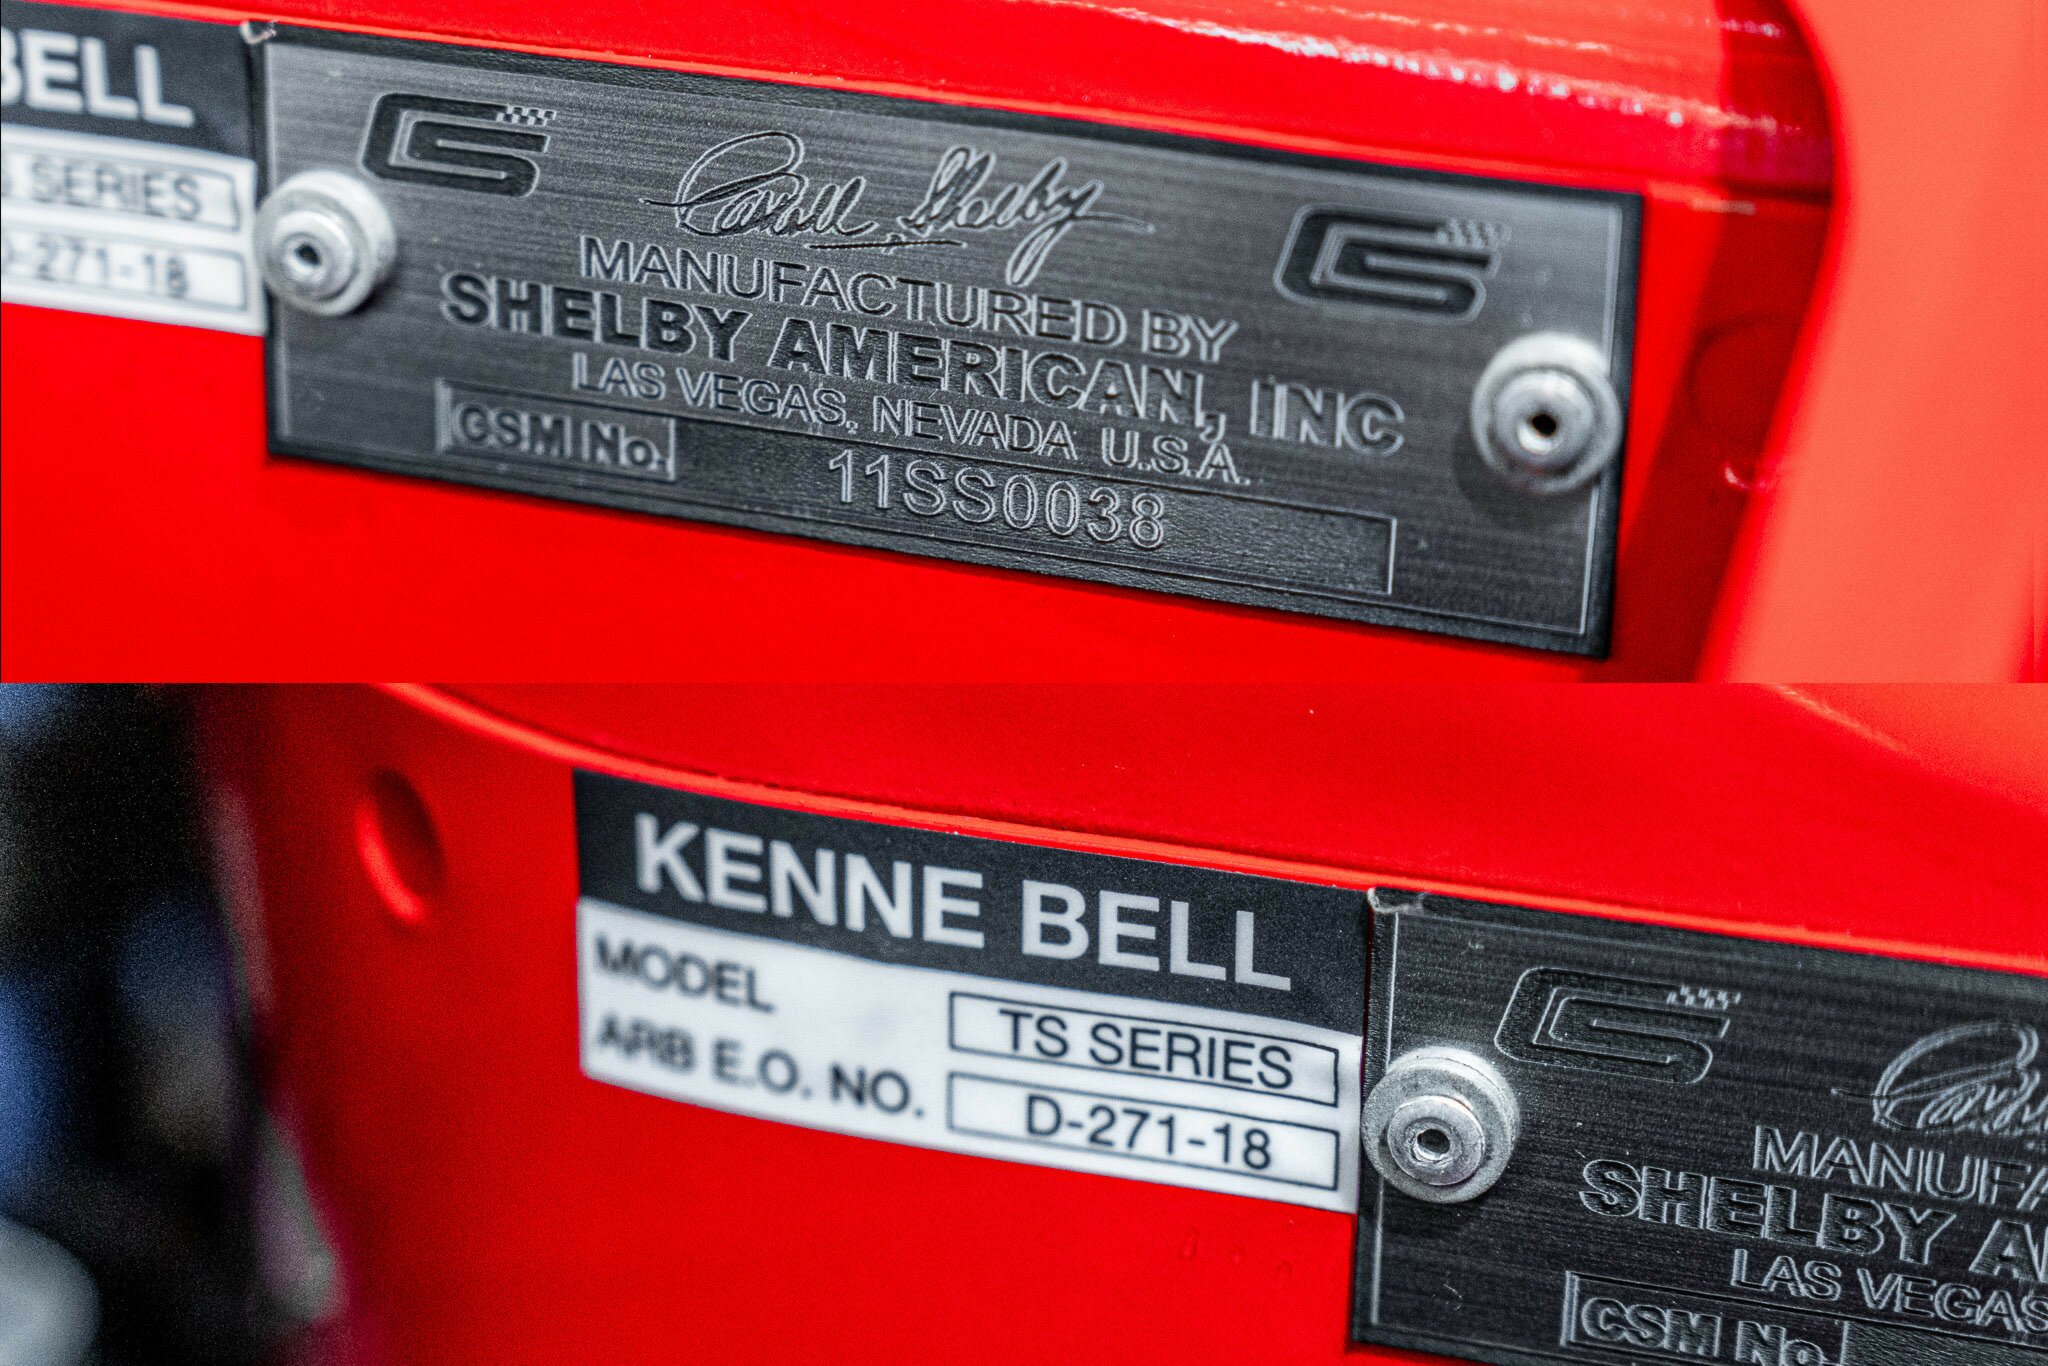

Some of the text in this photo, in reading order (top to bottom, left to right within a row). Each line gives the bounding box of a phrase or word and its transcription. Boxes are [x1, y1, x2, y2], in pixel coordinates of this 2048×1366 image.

[32, 154, 201, 220] SERIES
[577, 233, 1240, 363] MANUFACTURED BY
[438, 270, 1406, 457] SHELBY AMERICAN, INC
[450, 402, 573, 459] CSM
[570, 351, 667, 402] LAS
[870, 394, 1080, 463] NEVADA
[1100, 426, 1252, 486] U.S.A.
[827, 448, 1167, 549] 11SS0038
[634, 810, 1292, 993] KENNE BELL
[594, 932, 777, 1017] MODEL
[598, 1015, 926, 1120] ARB E.O. NO.
[999, 1007, 1294, 1092] TS SERIES
[1026, 1094, 1272, 1171] D-271-18
[1578, 1159, 2048, 1282] SHELBY A
[1730, 1248, 1842, 1301] LAS
[1581, 1297, 1721, 1358] CSM
